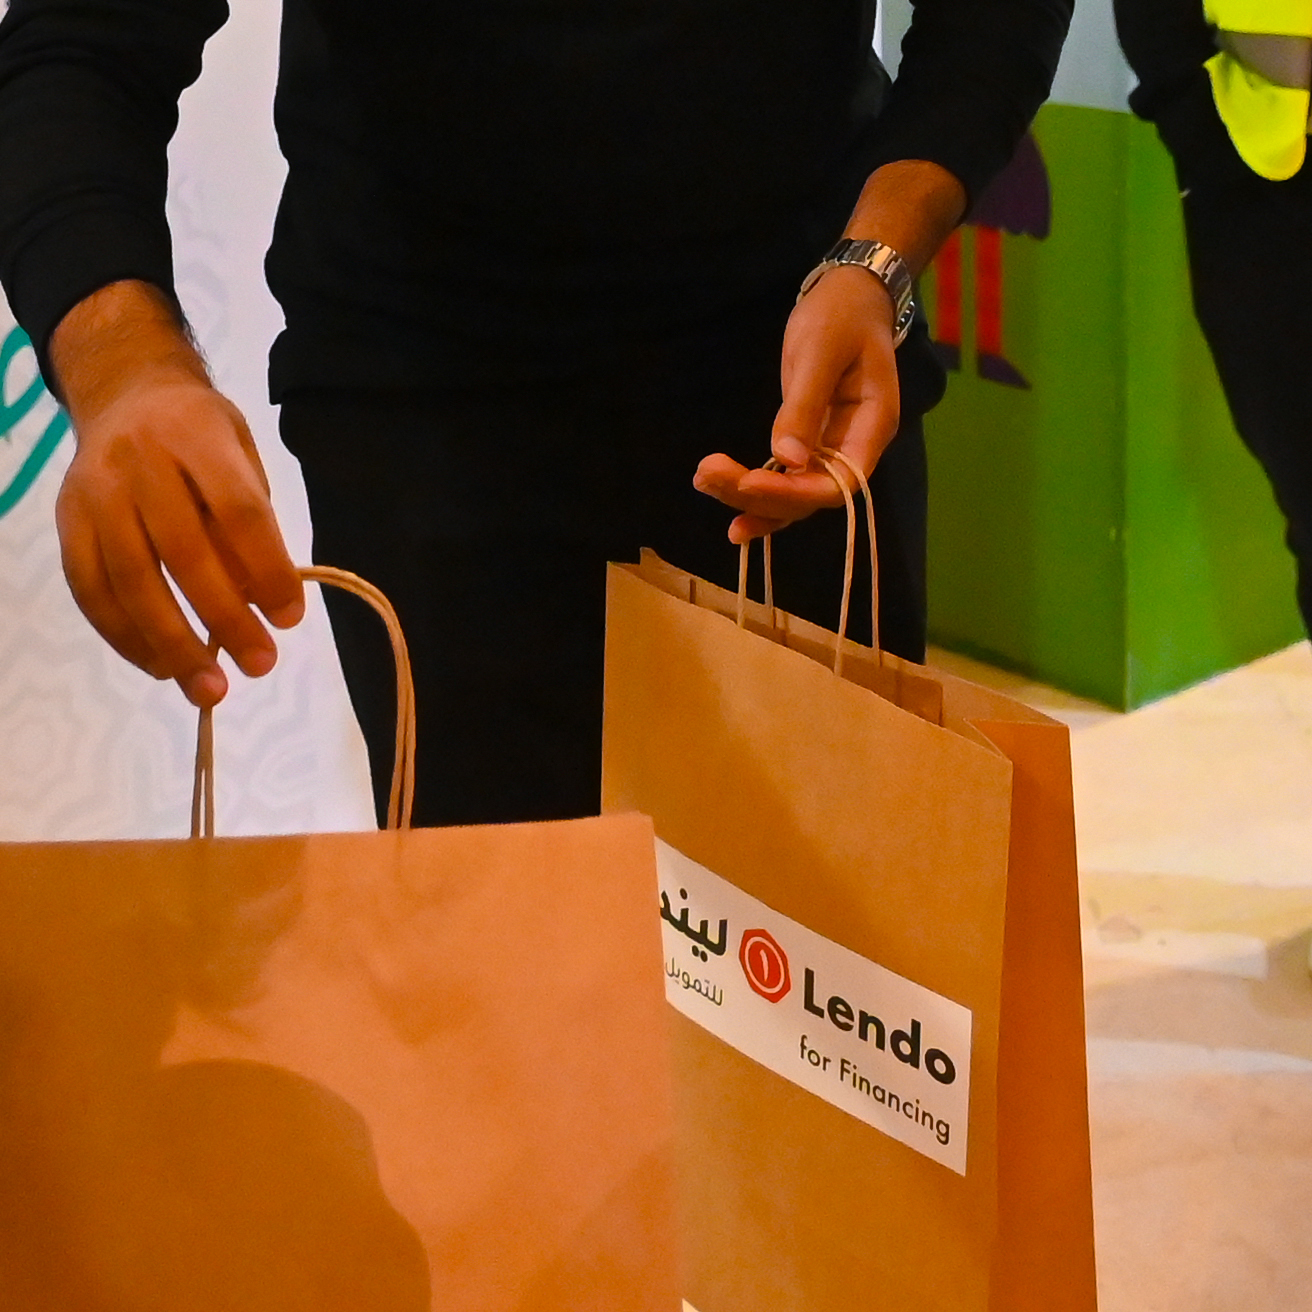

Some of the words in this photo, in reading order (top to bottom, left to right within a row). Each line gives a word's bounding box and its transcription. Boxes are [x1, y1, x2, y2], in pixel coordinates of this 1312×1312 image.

[660, 887, 728, 963] ليند
[665, 956, 723, 1006] للتمويل
[803, 966, 957, 1086] Lendo
[799, 1034, 831, 1072] for
[839, 1057, 950, 1146] Financing
